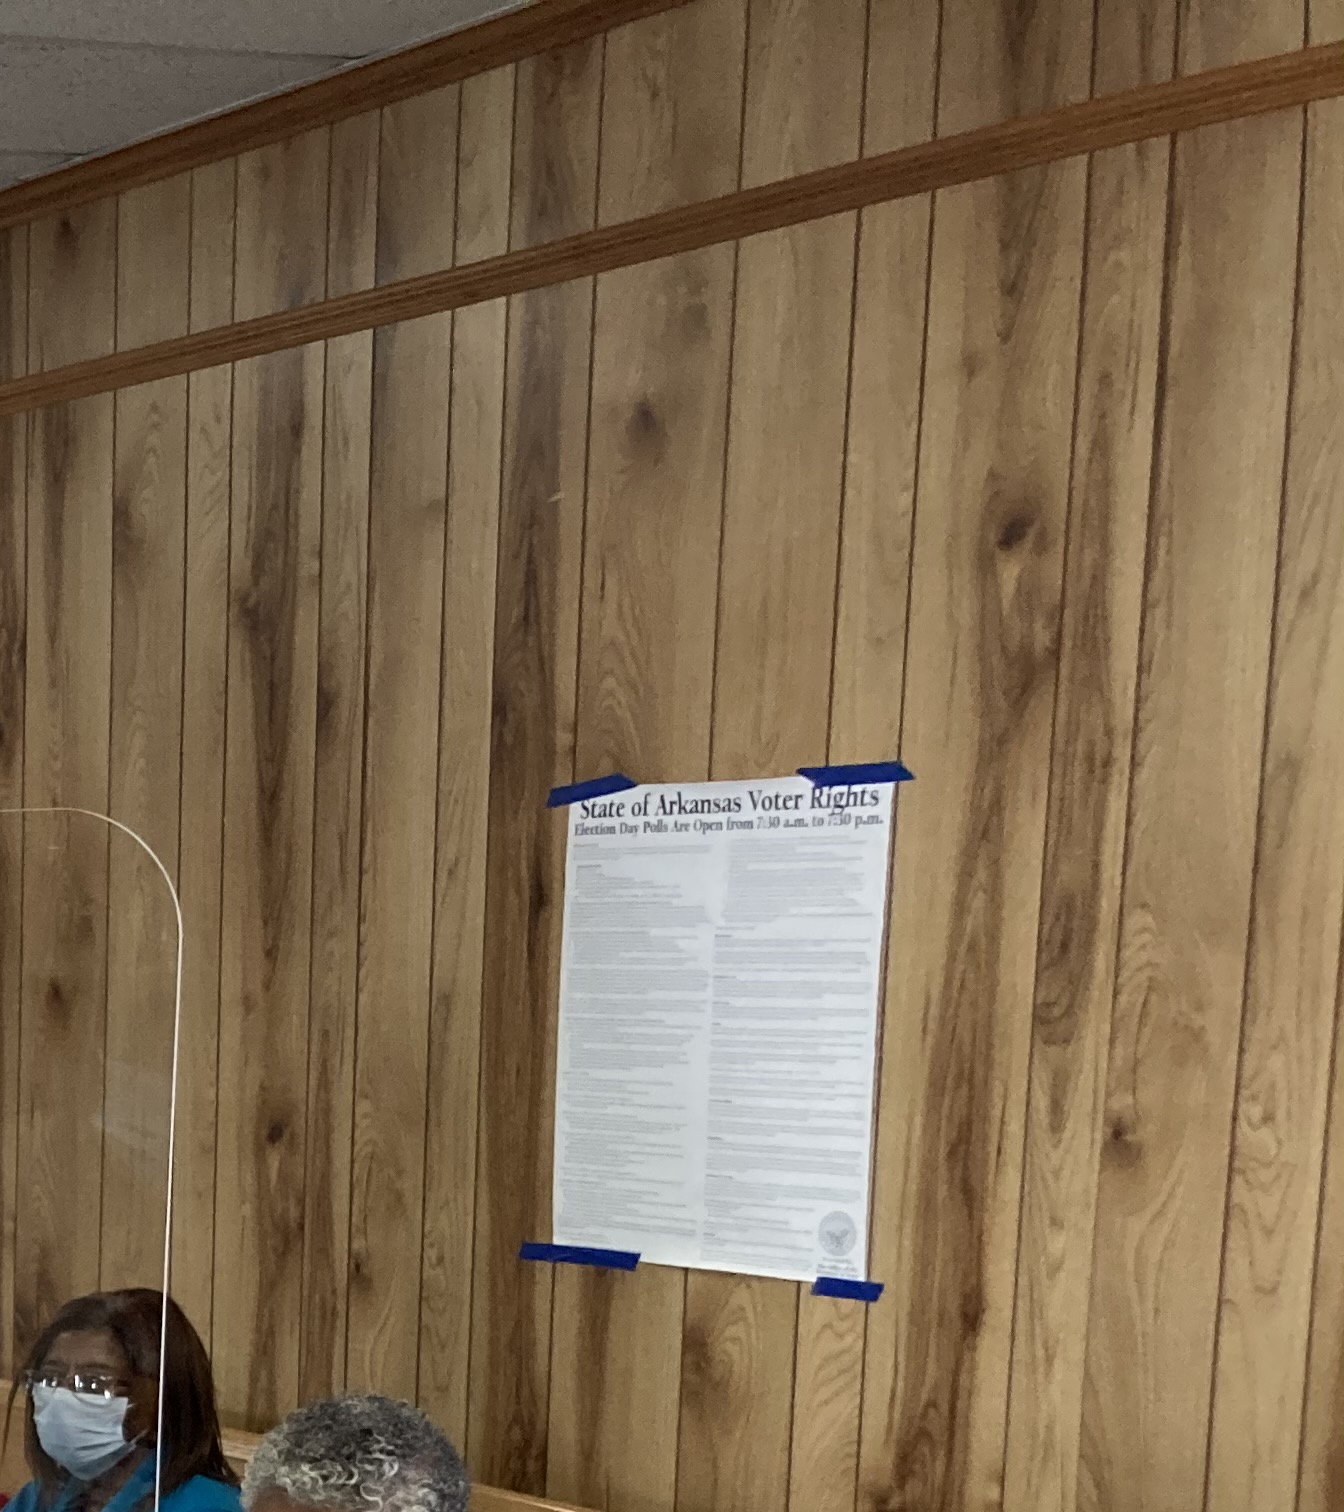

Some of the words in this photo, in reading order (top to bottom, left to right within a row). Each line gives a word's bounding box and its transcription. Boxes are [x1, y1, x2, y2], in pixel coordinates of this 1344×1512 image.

[580, 799, 625, 819] State
[631, 792, 651, 817] of
[654, 791, 742, 816] Arkansas
[748, 789, 805, 811] Voter
[810, 785, 880, 816] Rights
[574, 822, 616, 836] Election
[620, 822, 639, 836] Day
[643, 820, 668, 833] Polls
[673, 820, 691, 833] Are
[694, 819, 723, 834] Open
[727, 816, 754, 830] from
[783, 817, 808, 828] a.m.
[812, 816, 824, 827] to
[854, 814, 884, 829] p.m.
